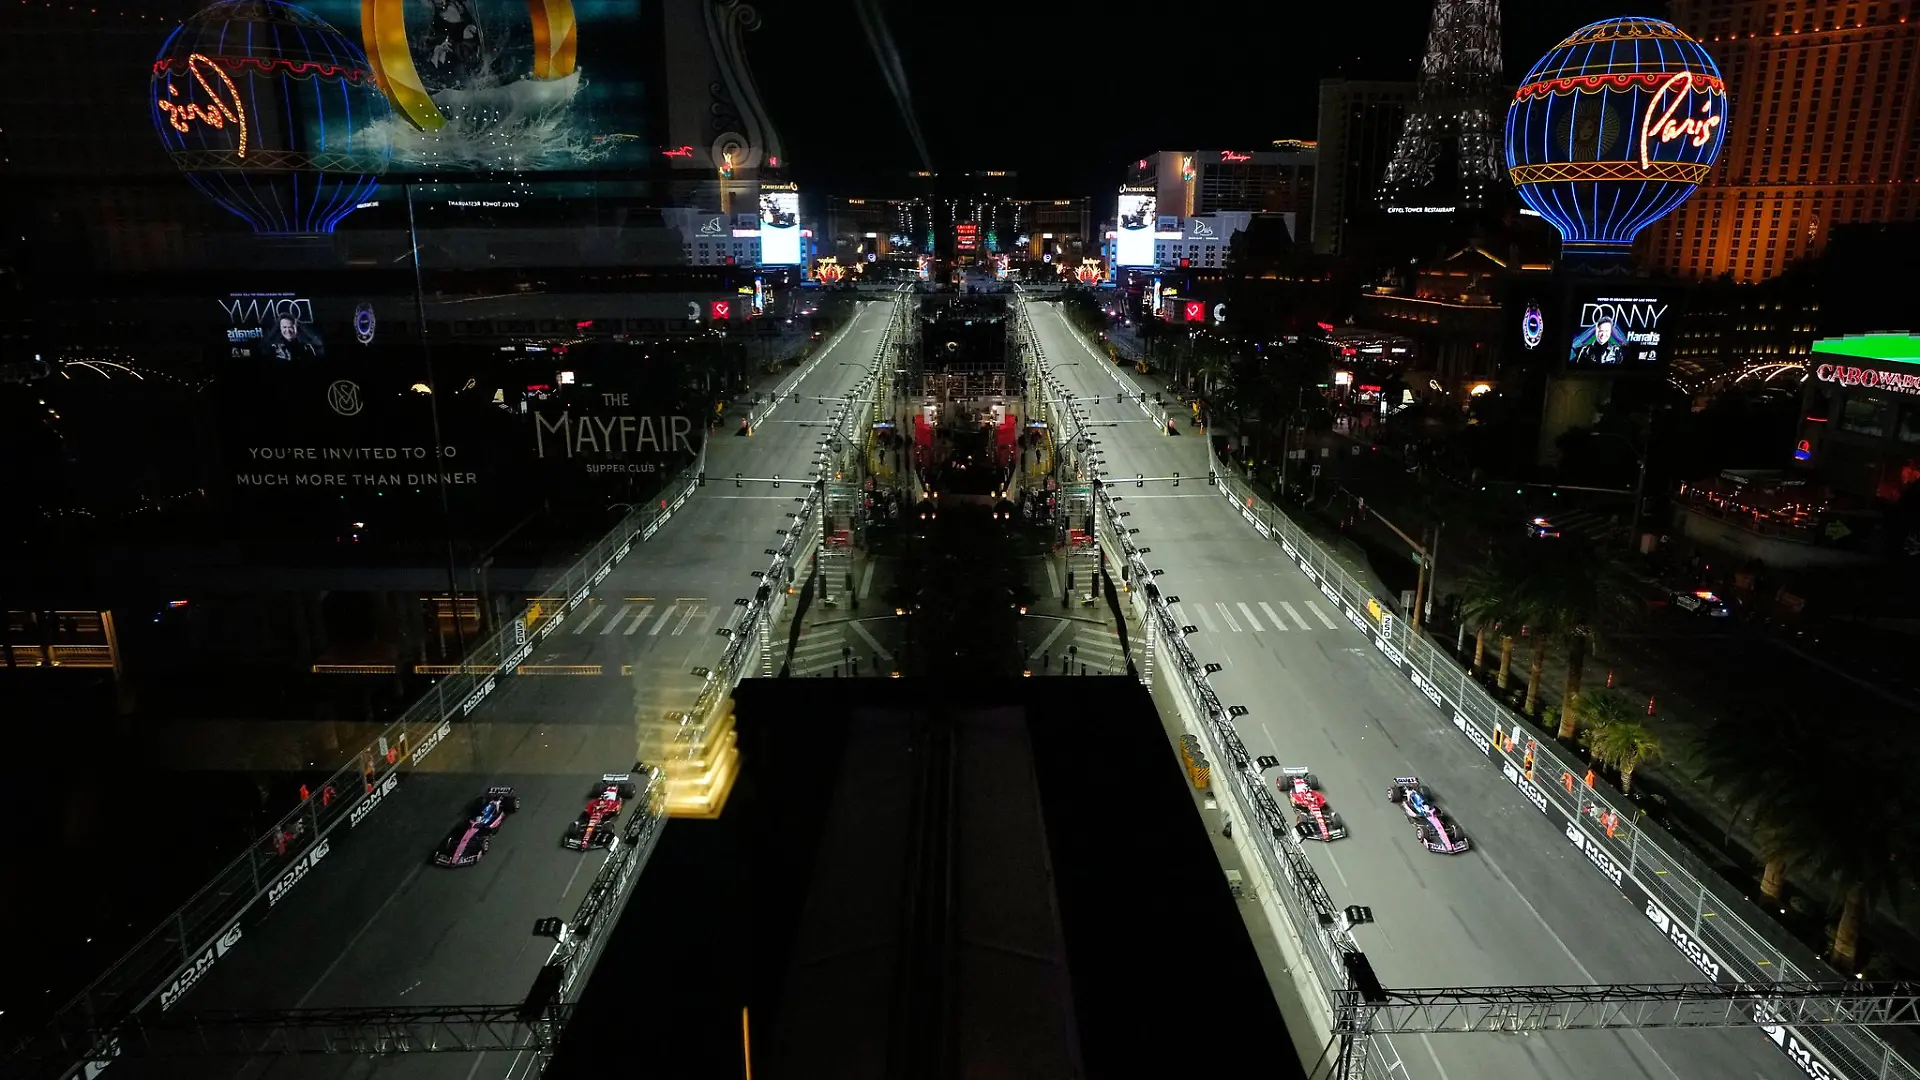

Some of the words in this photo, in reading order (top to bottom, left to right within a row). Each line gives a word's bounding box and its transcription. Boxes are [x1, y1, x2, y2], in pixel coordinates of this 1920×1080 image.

[1641, 72, 1720, 169] Paris
[1580, 303, 1668, 328] DONNY
[1816, 363, 1879, 388] CABO
[602, 393, 630, 406] THE
[534, 411, 698, 458] MAYFAIR
[249, 447, 317, 459] YOU'RE
[323, 447, 397, 459] INVITED
[402, 447, 426, 458] TO
[237, 474, 289, 485] MUCH
[296, 474, 347, 485] MORE
[352, 474, 401, 485] THAN
[408, 473, 477, 485] DINNER
[586, 464, 626, 473] SUPPER
[628, 464, 656, 473] CLUB
[1420, 679, 1442, 704] MGM
[1466, 723, 1490, 751] MGM
[1518, 775, 1547, 808] MGM
[1585, 840, 1623, 881] MGM
[1670, 934, 1718, 983] REWARDS
[1671, 923, 1719, 976] MGM
[1788, 1048, 1821, 1080] REW
[1789, 1037, 1837, 1080] MG
